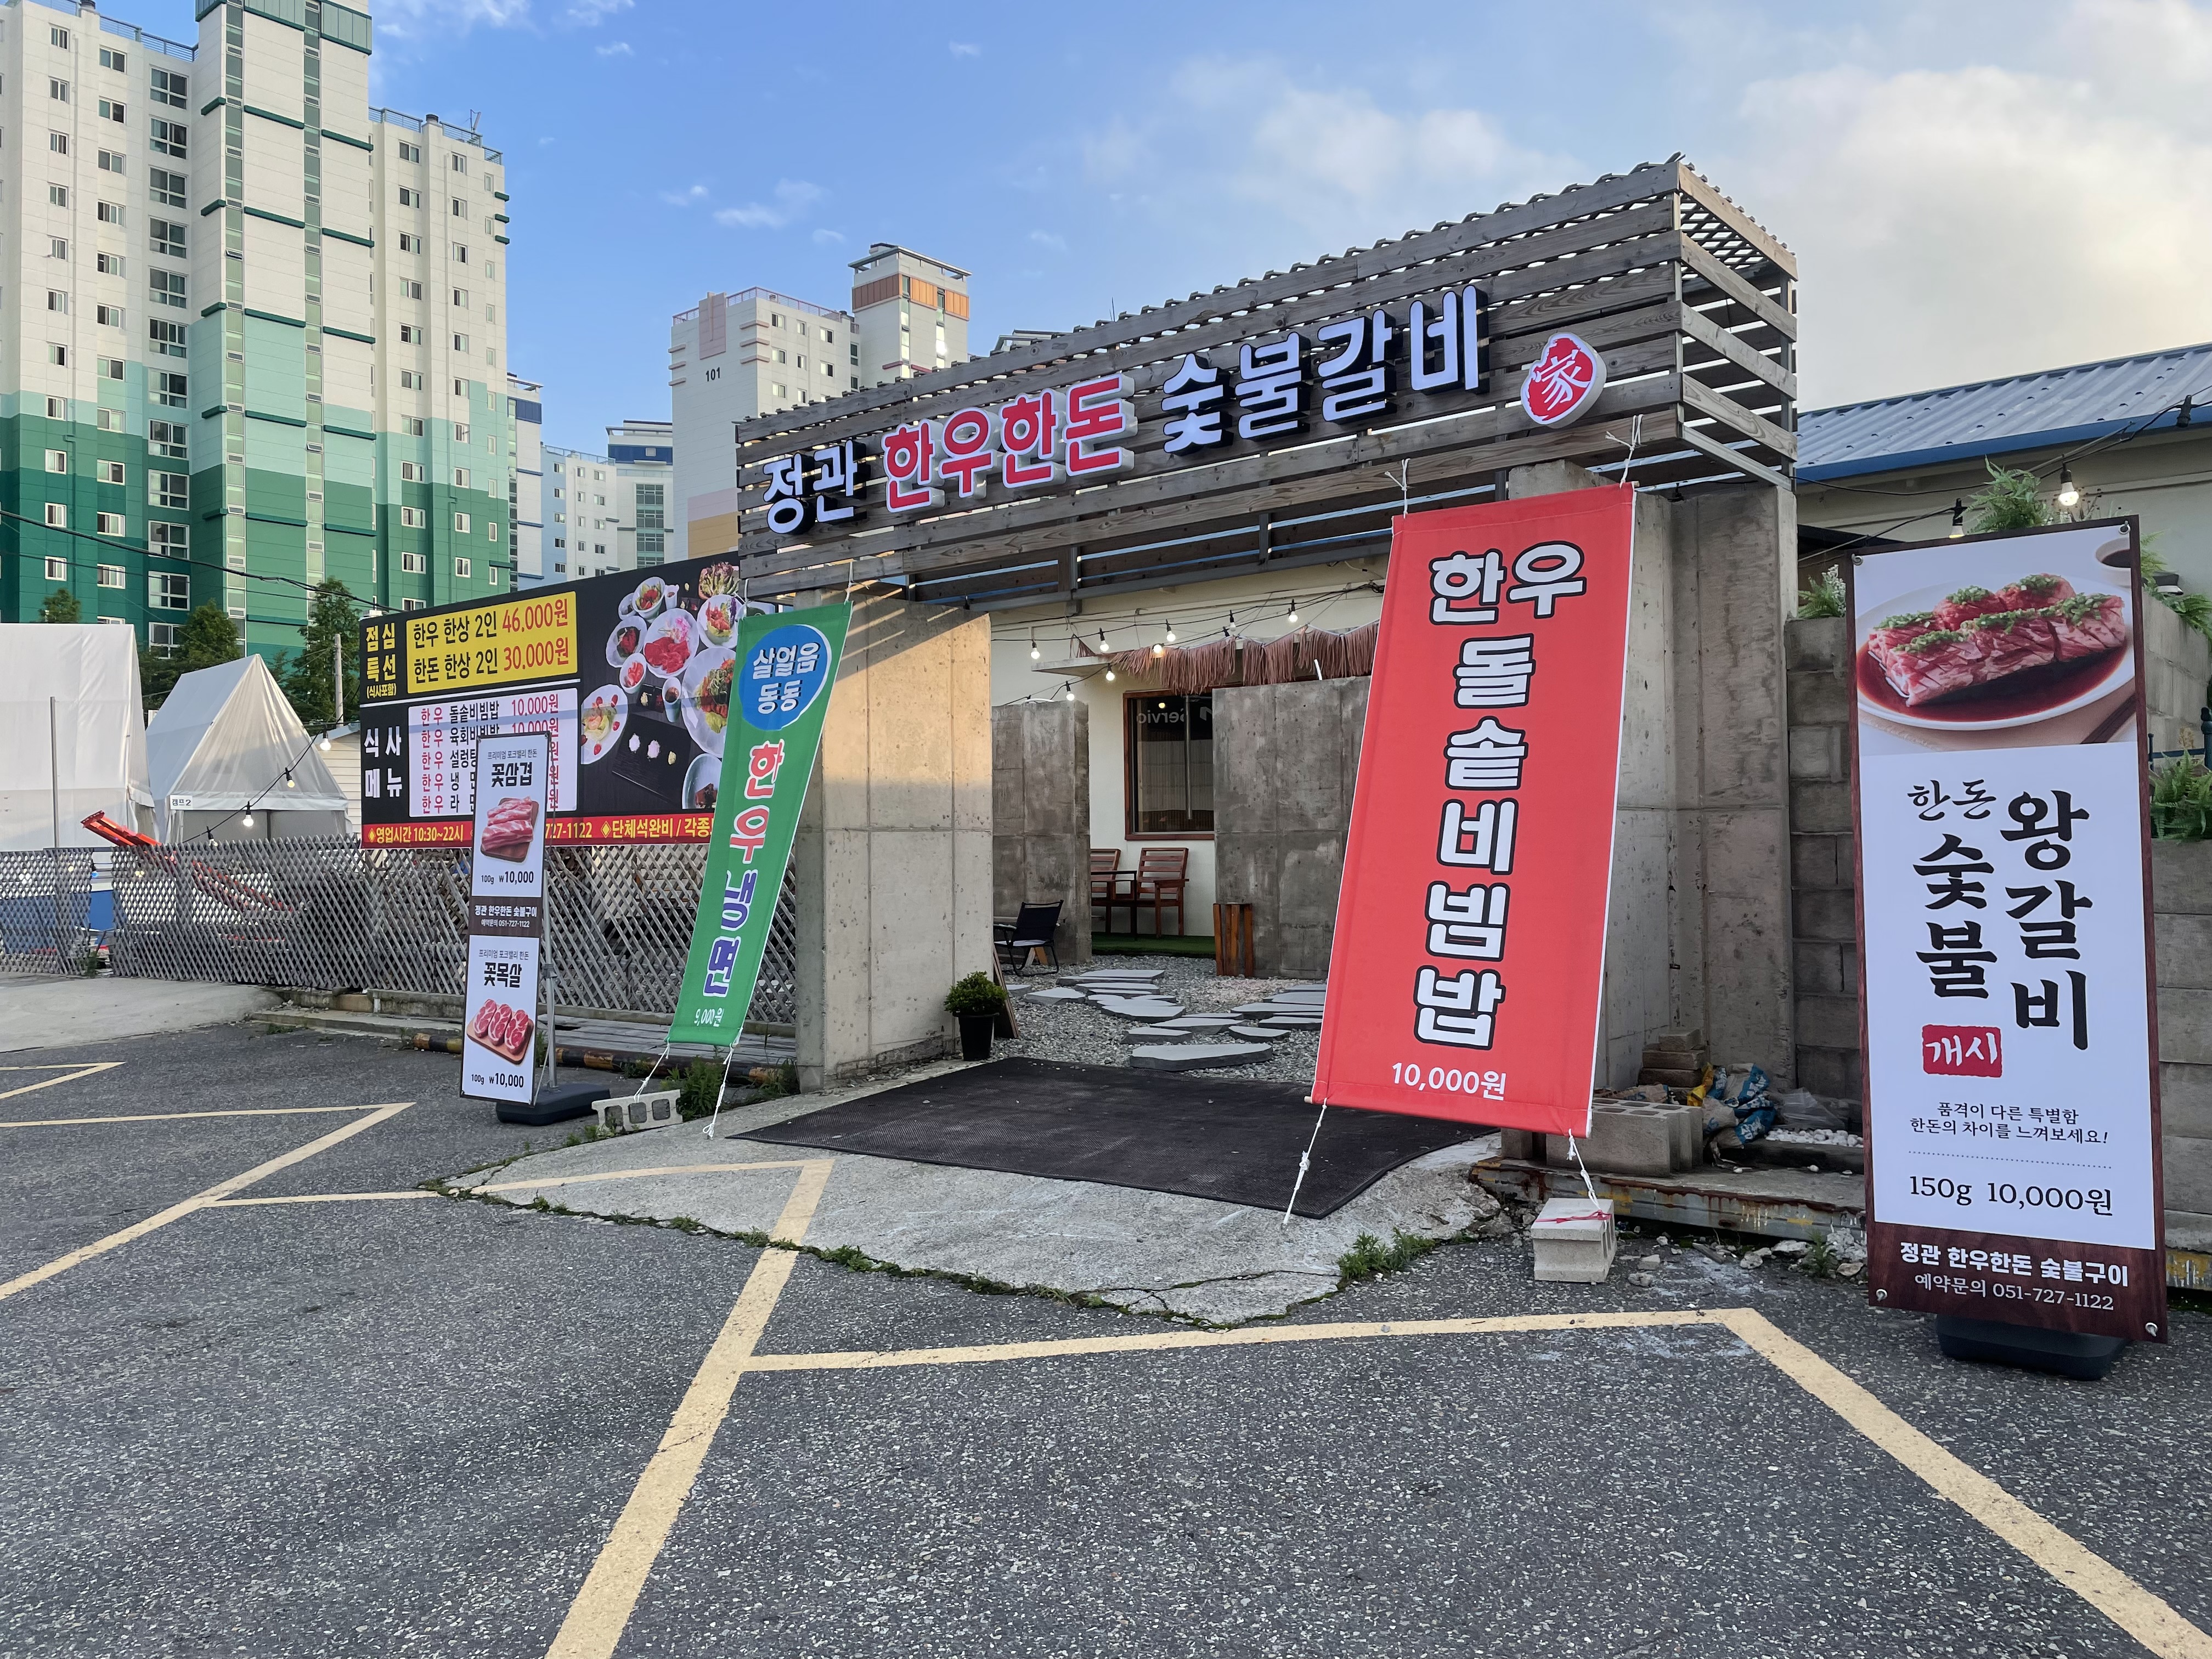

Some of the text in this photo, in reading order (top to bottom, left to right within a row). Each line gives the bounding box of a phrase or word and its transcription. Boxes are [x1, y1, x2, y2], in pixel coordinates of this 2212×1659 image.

[706, 367, 720, 381] 101
[763, 285, 1483, 534] 정관 한우한돈 숯불갈비
[1429, 540, 1587, 625] 한우
[366, 623, 395, 652] 점심
[413, 599, 568, 648] 한우 한상 2인 46.000원
[366, 654, 396, 681] 특선
[414, 637, 569, 684] 한돈 한상 2인 30.000원
[753, 642, 820, 680] 살얼음
[366, 683, 396, 699] (식사포함)
[758, 680, 803, 714] 동동
[449, 701, 499, 724] 돌솥비빔밥
[512, 693, 558, 716] 10.000원
[364, 725, 402, 758] 식사
[487, 751, 506, 760] 프리미엄
[528, 749, 537, 758] 한돈
[365, 768, 402, 798] 메뉴
[492, 762, 532, 787] 꽃삼겹
[1908, 779, 1996, 821] 한돈
[376, 826, 411, 843] 영업시간
[414, 825, 464, 842] 10:30~22시
[612, 818, 673, 838] 단체석완비
[1414, 633, 1536, 1051] 돌솥비빔밥
[481, 875, 494, 884] 100g
[475, 905, 537, 917] 정관 한우한돈 숯불구이
[1912, 833, 1997, 999] 숯불
[2000, 789, 2094, 1051] 왕갈비
[479, 949, 498, 958] 프리미엄
[520, 951, 529, 960] 한돈
[484, 962, 522, 988] 꽃목살
[694, 1007, 725, 1027] 9,000원
[1925, 1031, 1997, 1066] 개시
[472, 1074, 484, 1085] 100g
[1392, 1062, 1507, 1101] 10,000원
[1937, 1102, 2079, 1125] 품격이 다른 특별함
[1910, 1117, 2108, 1144] 한돈의 차이를 느껴보세요!
[1910, 1176, 2113, 1216] 150g 10,000원
[1900, 1242, 2128, 1286] 정관 한우한돈 숯불구이
[1915, 1273, 2114, 1311] 예약문의 051-727-1122
